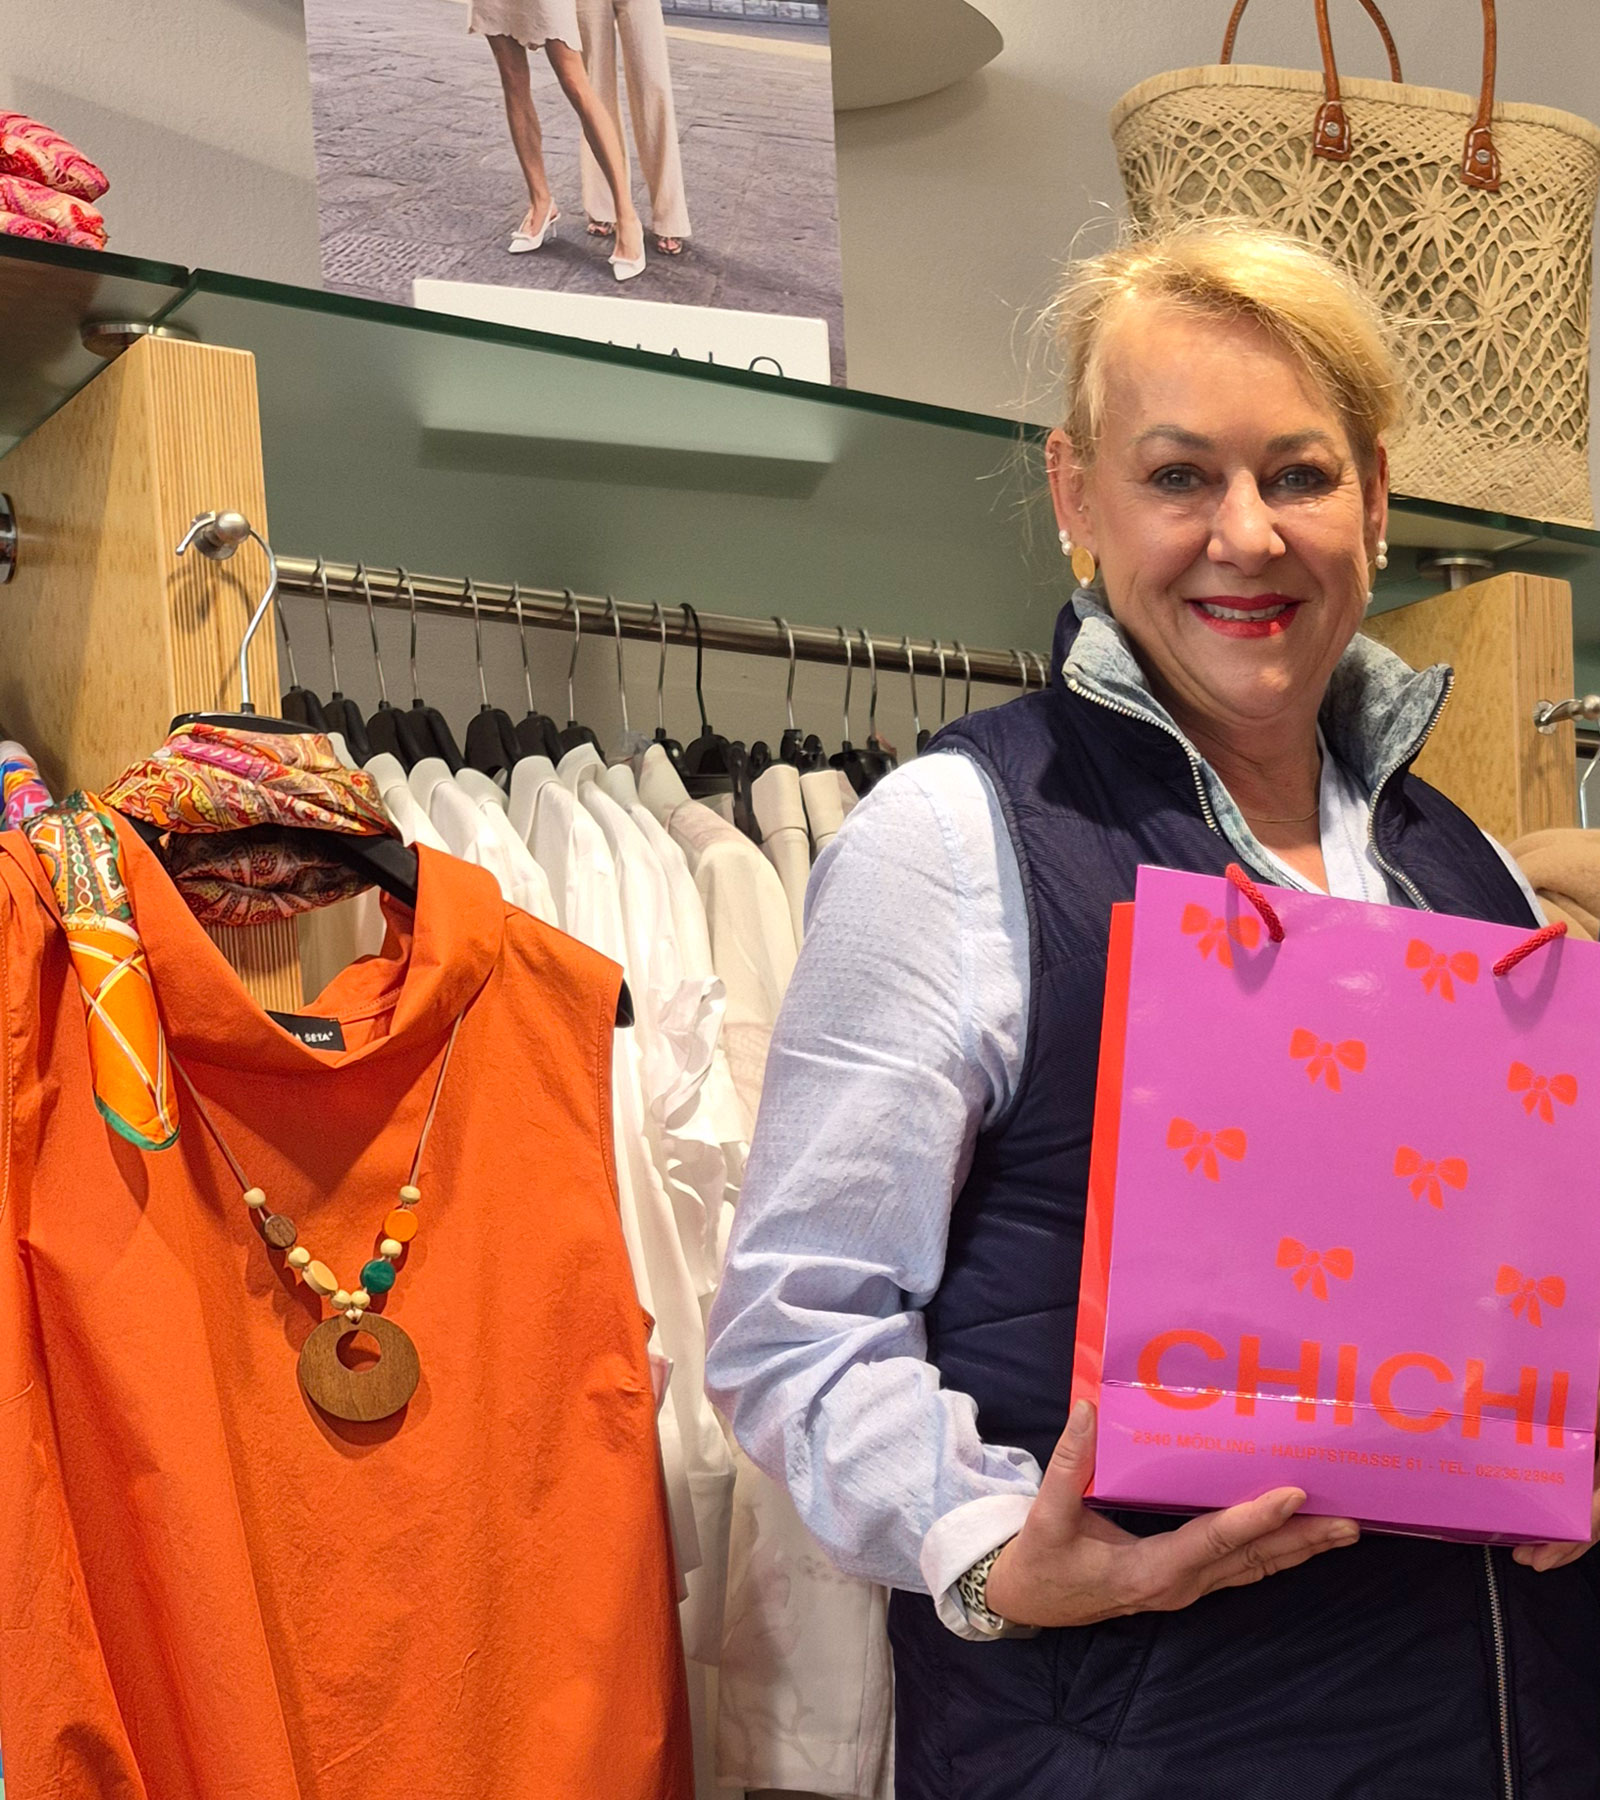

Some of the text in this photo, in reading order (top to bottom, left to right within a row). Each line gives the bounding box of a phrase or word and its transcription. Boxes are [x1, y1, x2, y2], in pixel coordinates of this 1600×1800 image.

[1137, 1329, 1569, 1448] CHICHI
[1133, 1431, 1171, 1446] 2340
[1176, 1432, 1256, 1455] MÖDLING
[1272, 1443, 1401, 1468] HAUPTSTRASSE
[1439, 1459, 1470, 1475] TEL.
